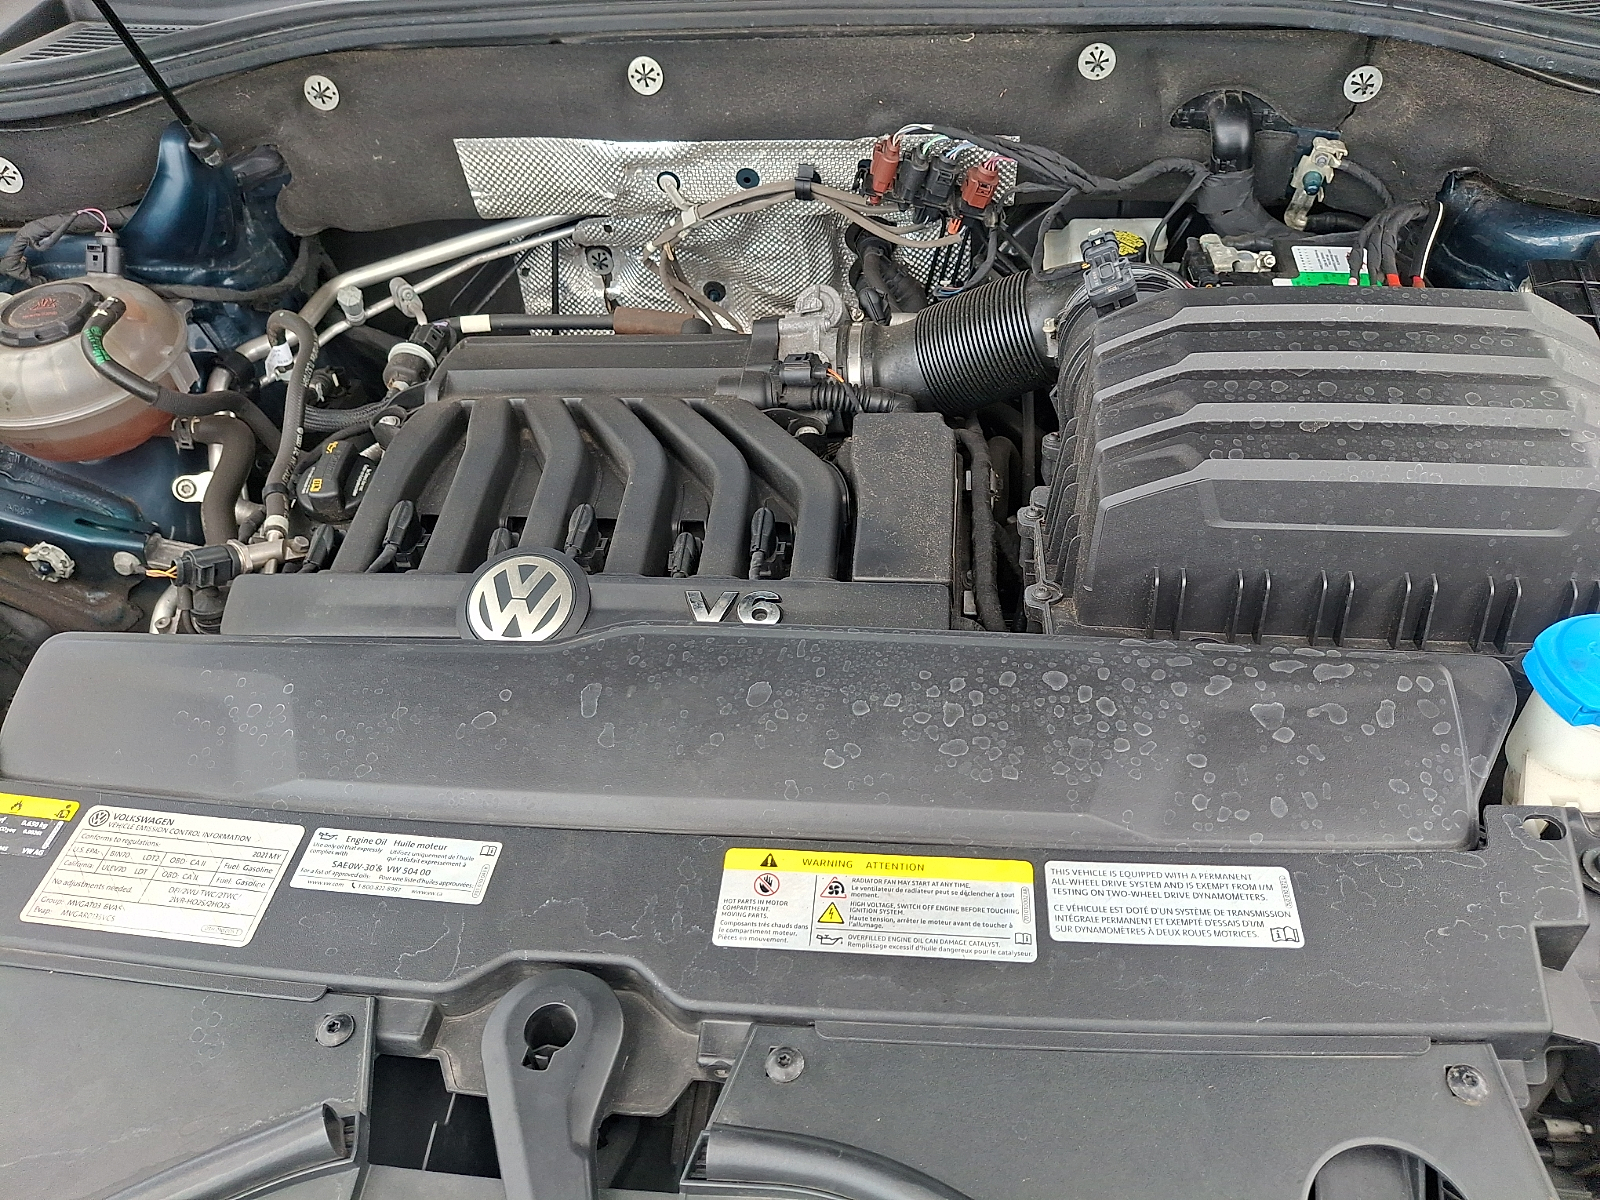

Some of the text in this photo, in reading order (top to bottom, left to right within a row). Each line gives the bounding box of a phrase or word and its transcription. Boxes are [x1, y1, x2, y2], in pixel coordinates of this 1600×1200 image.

[684, 590, 783, 625] V6
[113, 813, 175, 826] VOLKSWAGEN
[108, 821, 252, 842] VEHICLE EMISSION CONTROL INFORMATION
[80, 833, 112, 842] Conforms
[121, 838, 161, 848] regulations:
[345, 835, 448, 851] Engine Oil Huile moteur
[252, 851, 282, 860] 2021 MY
[356, 846, 383, 854] expressly
[223, 862, 240, 871] Fuel:
[242, 864, 274, 874] Gasoline
[331, 860, 348, 869] SAE
[375, 864, 383, 872] &
[402, 867, 418, 875] 504
[419, 868, 432, 876] 00
[802, 857, 925, 871] WARNING ATTENTION
[331, 870, 359, 878] approved
[1051, 868, 1070, 876] THIS
[1071, 868, 1107, 877] VEHICLE
[1119, 870, 1163, 879] EQUIPPED
[1164, 871, 1189, 880] WITH
[1190, 872, 1197, 880] A
[1198, 872, 1252, 881] PERMANENT
[62, 879, 105, 889] adjustments
[235, 879, 266, 888] Gasoline
[851, 877, 883, 885] RADIATOR
[1051, 878, 1100, 887] ALL-WHEEL
[1101, 879, 1128, 888] DRIVE
[1129, 880, 1162, 889] SYSTEM
[1163, 881, 1184, 890] AND
[1186, 882, 1194, 890] IS
[1195, 882, 1229, 890] EXEMPT
[1231, 883, 1257, 891] FROM
[40, 896, 64, 905] Group:
[959, 890, 995, 898] déclencher
[1052, 887, 1268, 901] TESTING ON TWO-WHEEL DRIVE DYNAMOMETERS.
[986, 907, 1020, 915] TOUCHING
[1053, 904, 1065, 912] CE
[1065, 903, 1108, 913] VÉHICULE
[1109, 906, 1124, 914] EST
[1125, 905, 1149, 915] DOTÉ
[1150, 907, 1174, 915] D'UN
[1226, 909, 1292, 918] TRANSMISSION
[719, 920, 757, 928] Composants
[1054, 913, 1241, 927] INTÉGRALE PERMANENT ET EXEMPTÉ D'ESSAIS
[725, 927, 771, 936] compartiment
[1055, 925, 1073, 933] SUR
[1074, 925, 1146, 936] DYNAMOMÈTRES
[1155, 928, 1181, 937] DEUX
[1182, 929, 1212, 938] ROUES
[1213, 930, 1260, 939] MOTRICES.
[748, 936, 789, 944] mouvement.
[847, 933, 886, 942] OVERFILLED
[939, 938, 966, 946] DAMAGE
[968, 940, 1001, 948] CATALYST.
[847, 941, 887, 950] Remplissage
[888, 943, 914, 951] excessif
[915, 944, 937, 952] d'huile
[938, 945, 973, 954] dangereux
[997, 949, 1033, 958] catalyseur.
